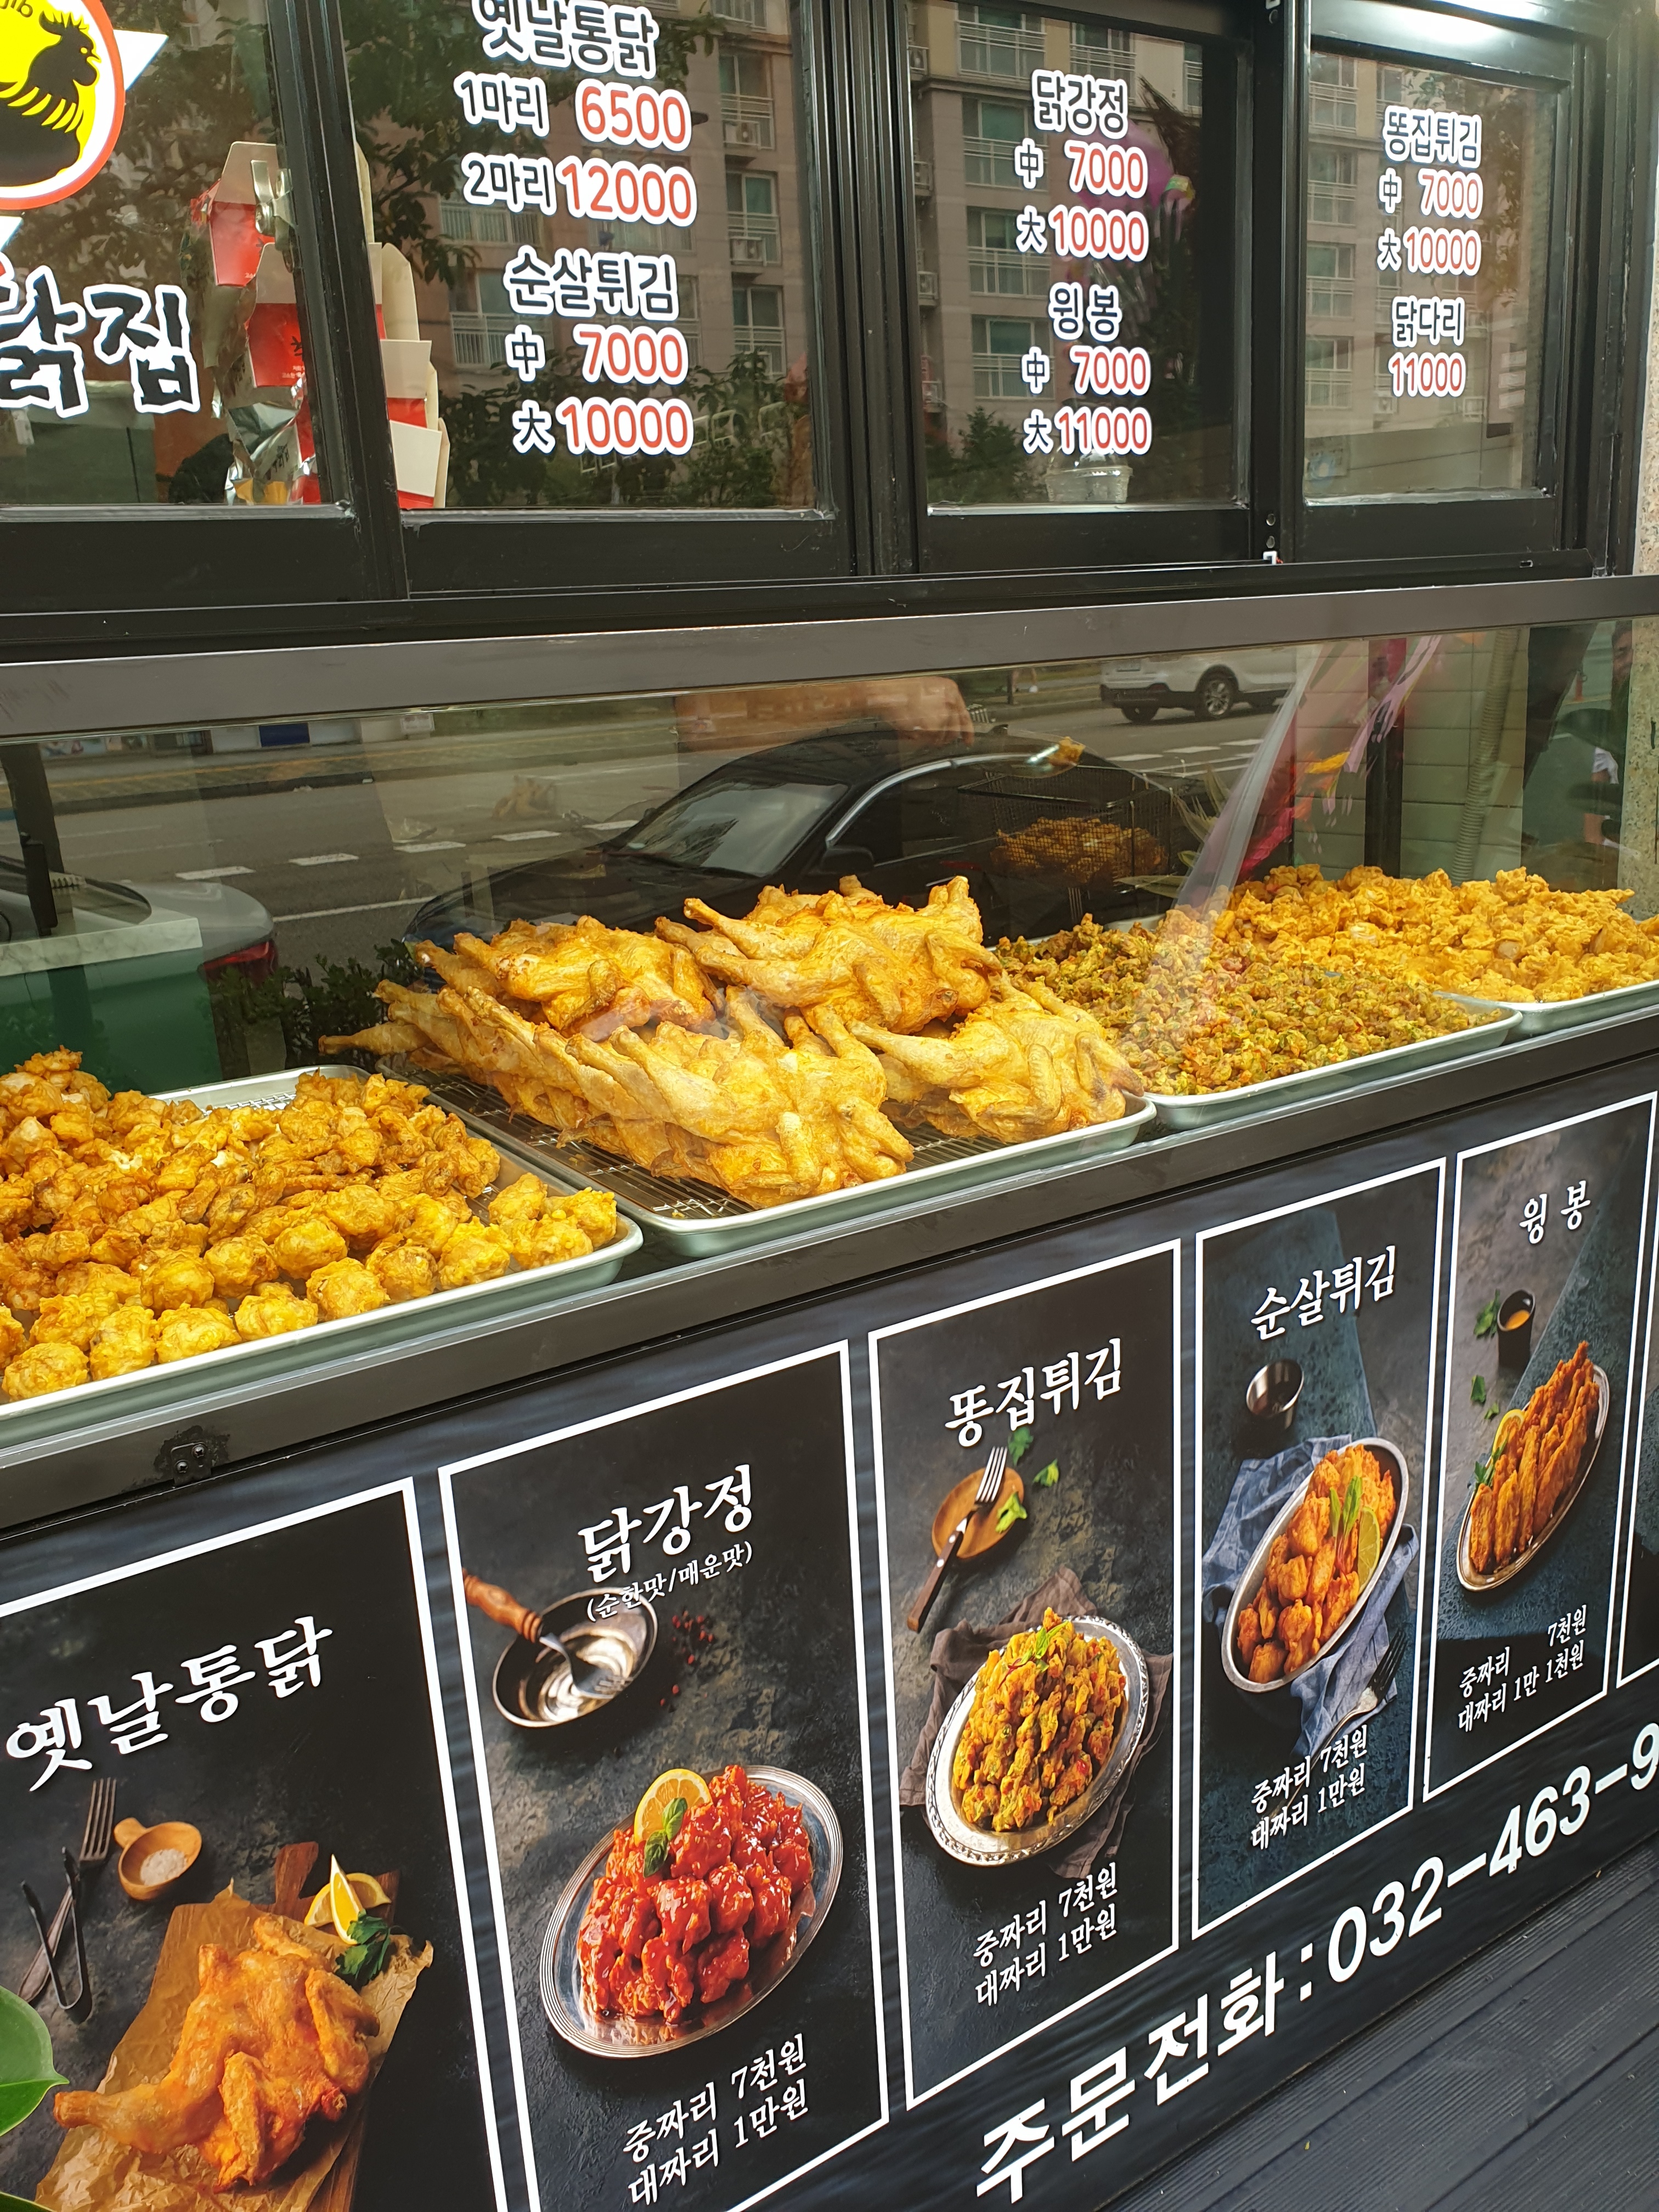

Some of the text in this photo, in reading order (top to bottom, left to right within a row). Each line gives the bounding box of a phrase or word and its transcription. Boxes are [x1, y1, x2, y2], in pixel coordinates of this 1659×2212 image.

[477, 0, 655, 73] 옛날통닭
[460, 77, 687, 146] 1마리 6500
[1036, 75, 1128, 134] 닭강정
[1386, 110, 1479, 163] 똥집튀김
[466, 158, 693, 221] 2마리 12000
[1018, 144, 1144, 193] 中 7000
[1382, 173, 1480, 215] 中 7000
[1019, 210, 1145, 257] 大 10000
[1380, 232, 1478, 271] 大 10000
[509, 252, 674, 315] 순살튀김
[510, 331, 685, 380] 中 7000
[1395, 300, 1463, 345] 닭다리
[1025, 350, 1147, 391] 中 7000
[1391, 357, 1463, 393] 11000
[517, 403, 690, 450] 大 10000
[1026, 411, 1148, 450] 大 11000
[1251, 1245, 1397, 1340] 순살튀김
[944, 1338, 1122, 1448] 똥집튀김
[578, 1464, 752, 1583] 닭강정
[1459, 1604, 1587, 1698] 중짜리 7천원
[5, 1615, 333, 1792] 옛날통닭
[1458, 1639, 1584, 1732] 대짜리 1만 1천원
[1251, 1724, 1368, 1814] 중짜리 7천원
[1250, 1762, 1365, 1850] 대짜리 1만원
[973, 1861, 1118, 1968] 중짜리 7천원
[975, 1903, 1117, 2006] 대짜리 1만원
[623, 2033, 806, 2163] 중짜리 7천원
[628, 2078, 809, 2206] 대짜리 1만원
